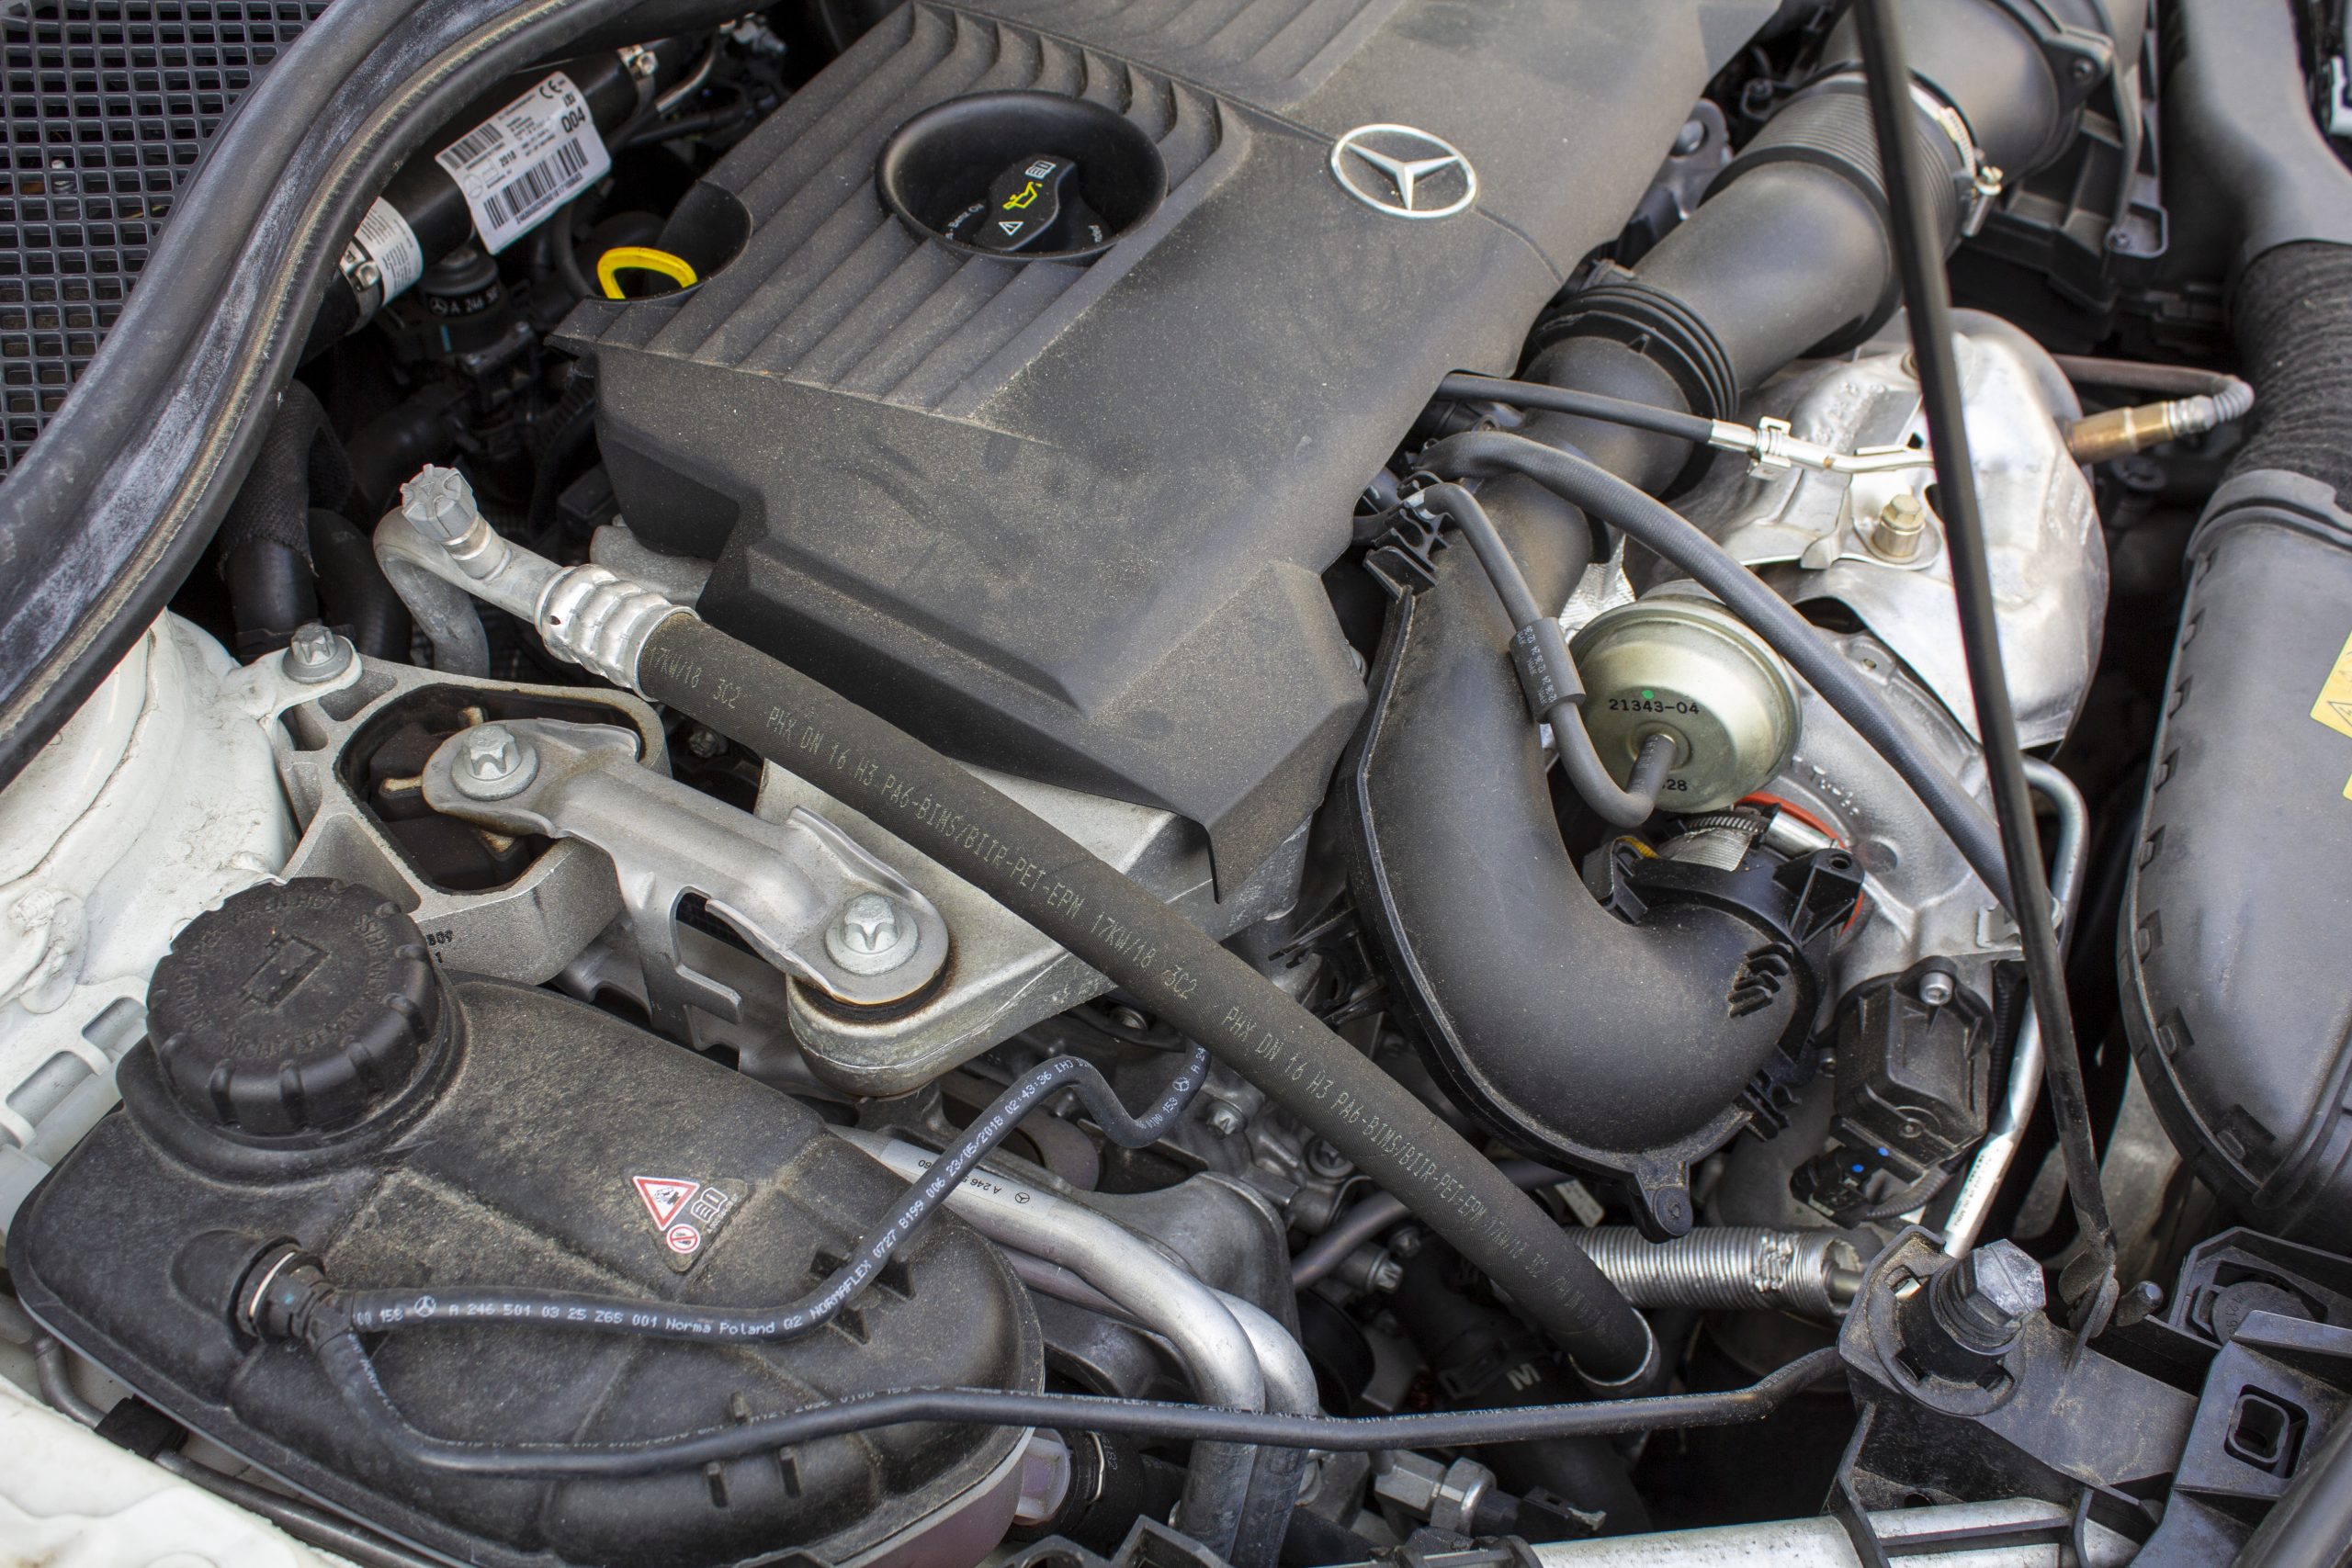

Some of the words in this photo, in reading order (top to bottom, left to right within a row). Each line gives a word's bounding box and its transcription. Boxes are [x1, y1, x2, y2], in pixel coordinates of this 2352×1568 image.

[1609, 698, 1700, 715] 21343-04
[1660, 778, 1688, 792] 28
[448, 1304, 458, 1315] A
[467, 1303, 494, 1315] 246
[503, 1303, 530, 1316] 501
[567, 1308, 587, 1321] 25
[631, 1314, 657, 1326] 001
[665, 1317, 712, 1334] Norma
[719, 1320, 775, 1335] Poland
[809, 1260, 872, 1319] NORMAFLEX
[873, 1230, 897, 1259] 0727
[945, 1115, 1004, 1176] 23/05/2018
